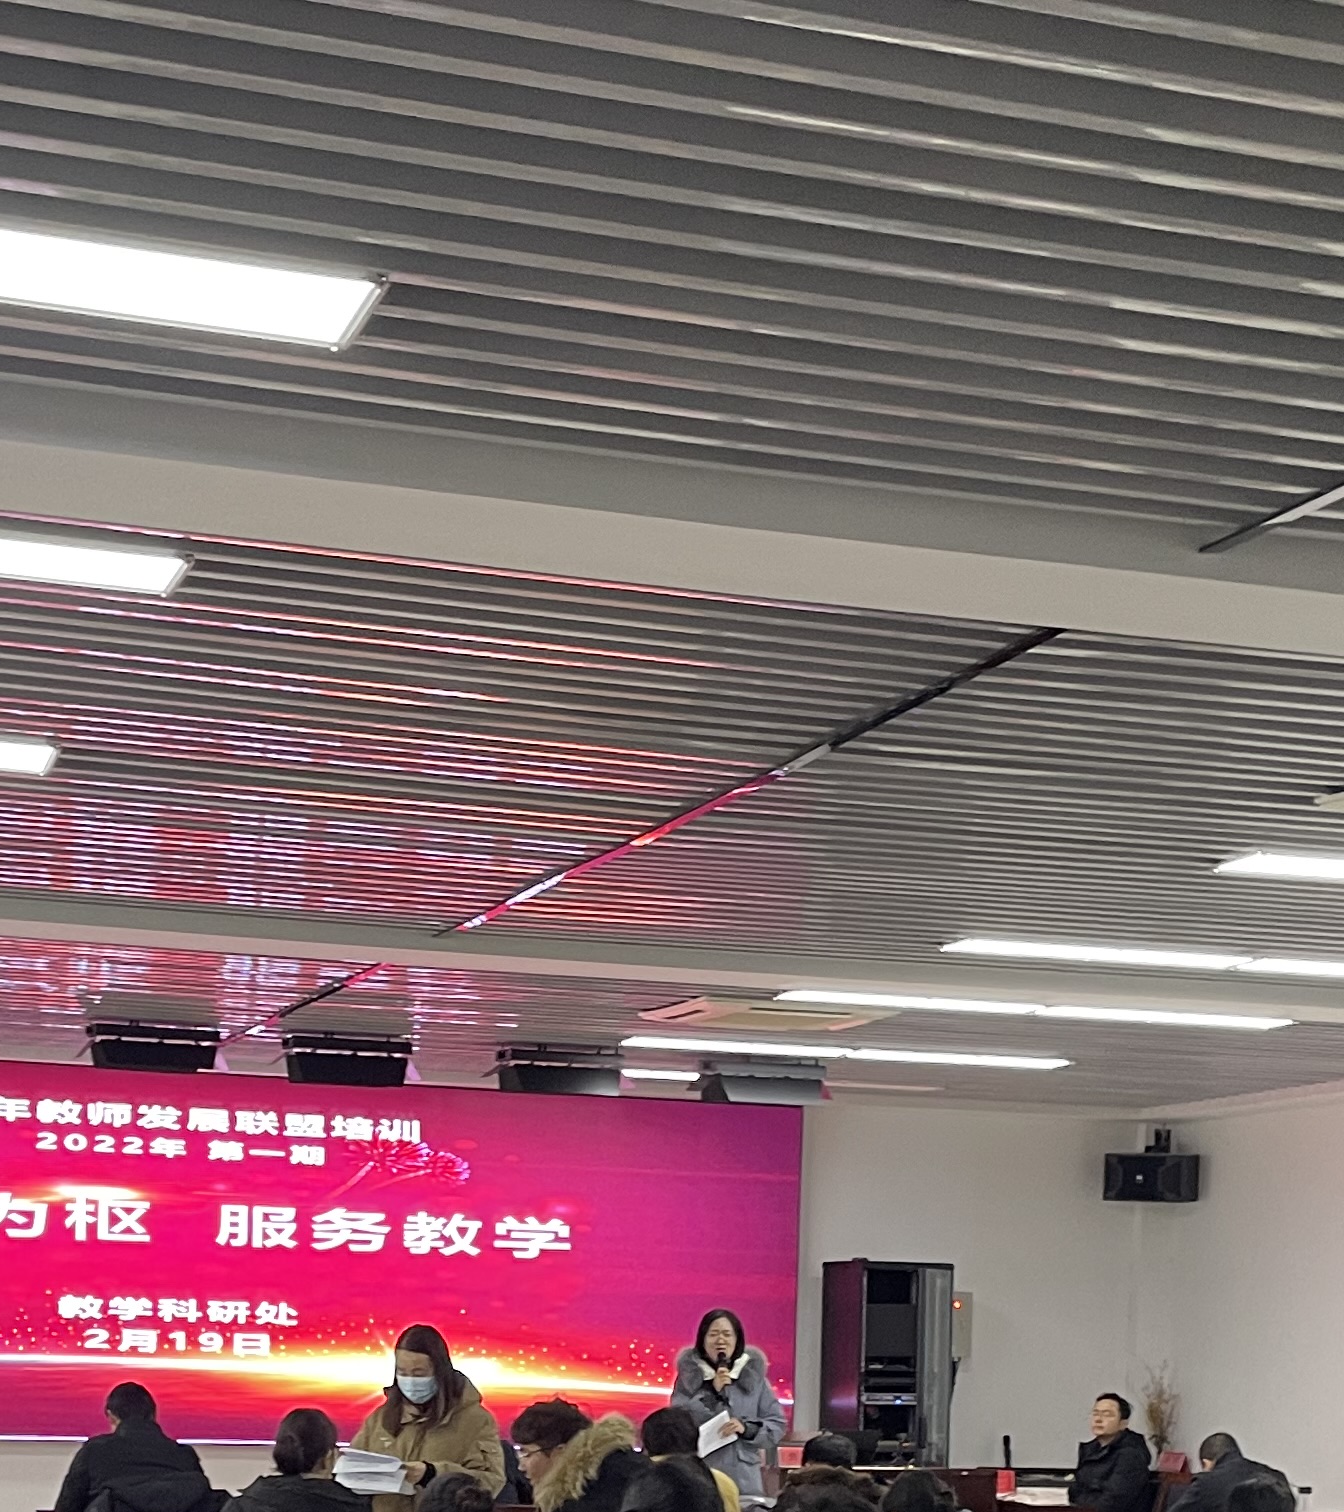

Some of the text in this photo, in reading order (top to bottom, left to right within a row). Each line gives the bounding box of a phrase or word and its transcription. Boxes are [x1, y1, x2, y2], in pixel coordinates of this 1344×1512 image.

[35, 1131, 327, 1166] 2022年 第一期
[215, 1203, 574, 1260] 服务教学
[57, 1293, 299, 1328] 教学科研处
[83, 1327, 273, 1357] 2月19日
